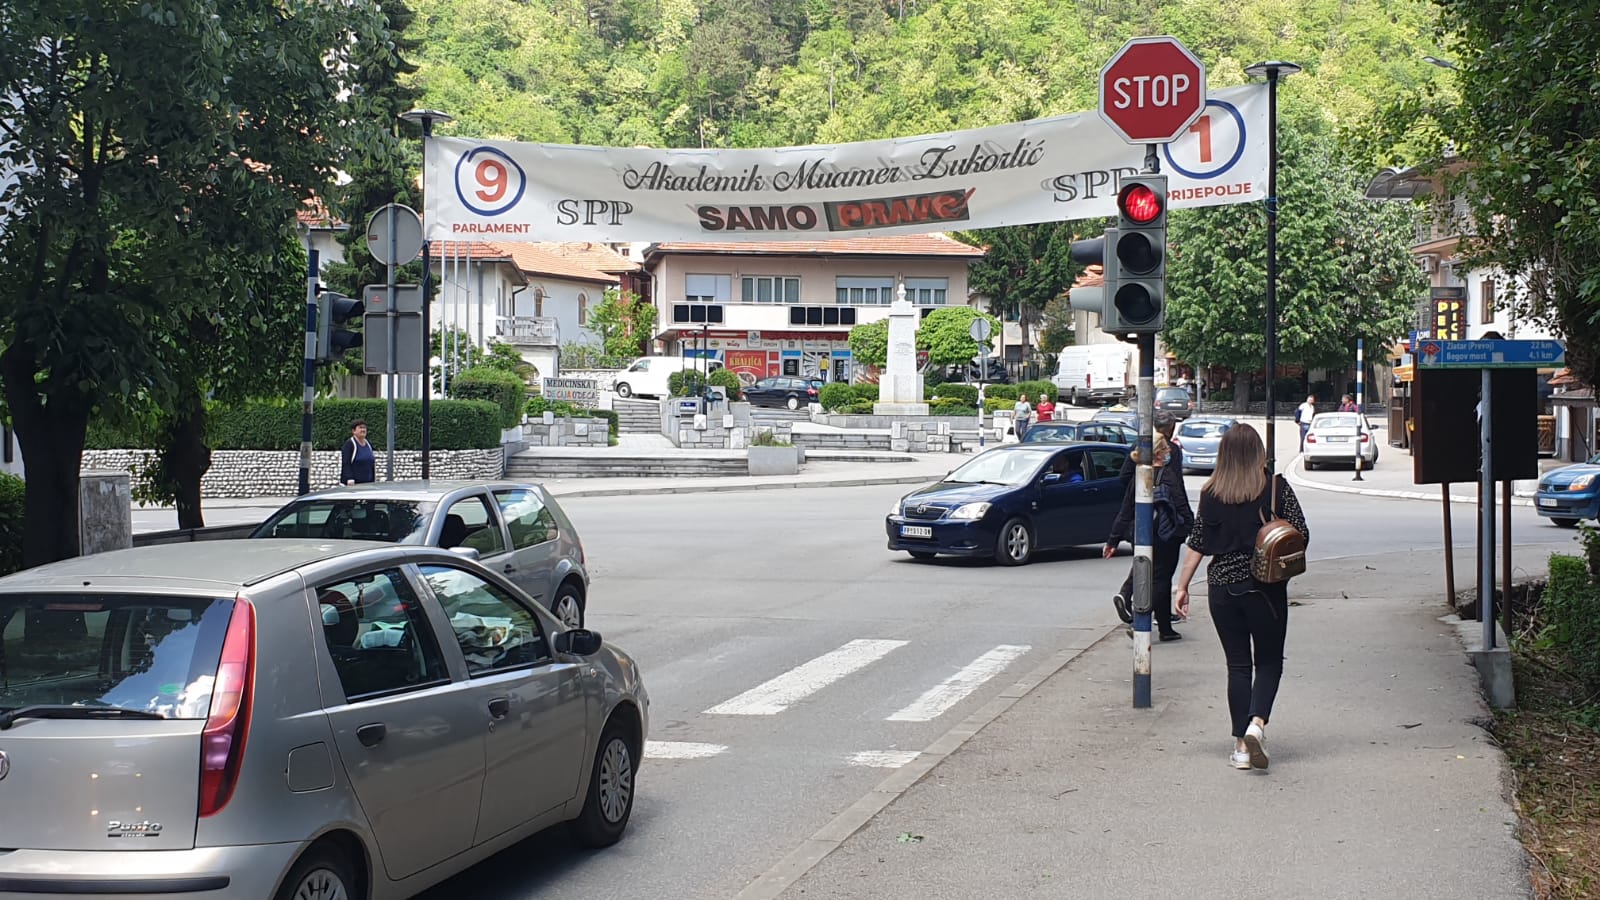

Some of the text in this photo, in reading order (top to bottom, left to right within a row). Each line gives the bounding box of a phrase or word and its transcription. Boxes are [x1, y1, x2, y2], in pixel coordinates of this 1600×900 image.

[1113, 73, 1190, 109] STOP
[1189, 115, 1212, 163] 1
[623, 138, 1045, 192] Akademik Muamer Zukorlić
[475, 159, 508, 202] 9
[556, 199, 633, 226] SPP
[697, 205, 817, 231] SAMO
[452, 223, 531, 233] PARLAMENT
[1446, 342, 1467, 350] Zlatar
[1446, 353, 1468, 362] Begov
[546, 379, 591, 389] MEDICINSKA
[107, 820, 163, 831] Punto
